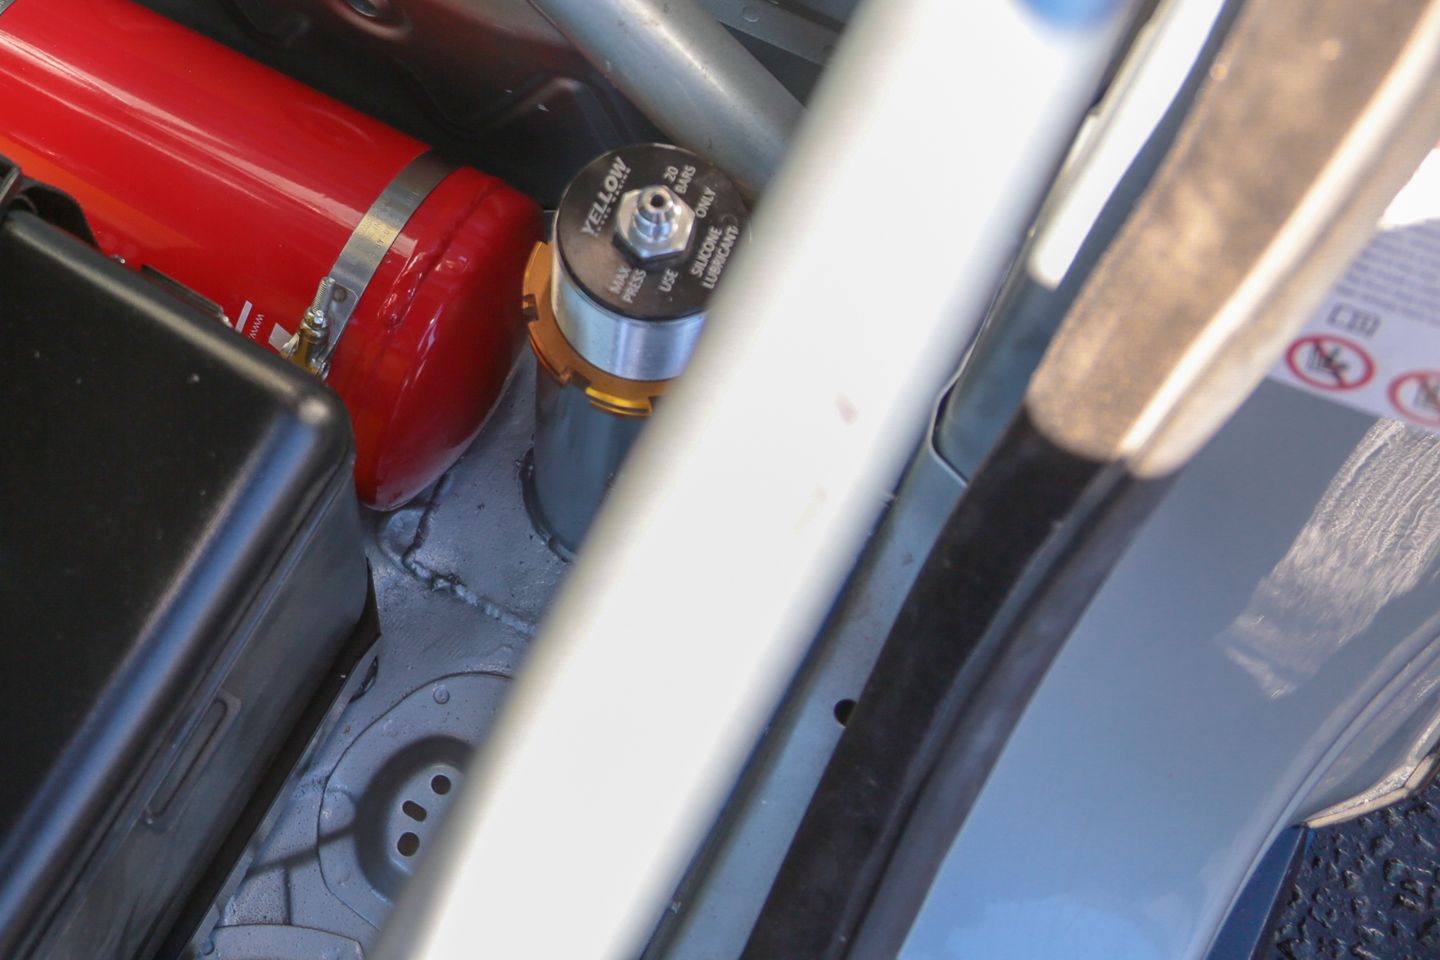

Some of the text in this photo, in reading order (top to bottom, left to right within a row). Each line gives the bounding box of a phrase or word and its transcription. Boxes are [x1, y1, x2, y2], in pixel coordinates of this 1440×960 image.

[664, 166, 679, 182] 20
[675, 164, 696, 195] BARS
[582, 156, 628, 235] YELLOW
[696, 186, 716, 219] ONLY
[691, 225, 723, 278] SILICONE
[703, 225, 740, 289] LUBRICANT
[610, 265, 632, 294] MAX
[623, 269, 647, 303] PRESS
[659, 268, 678, 293] USE
